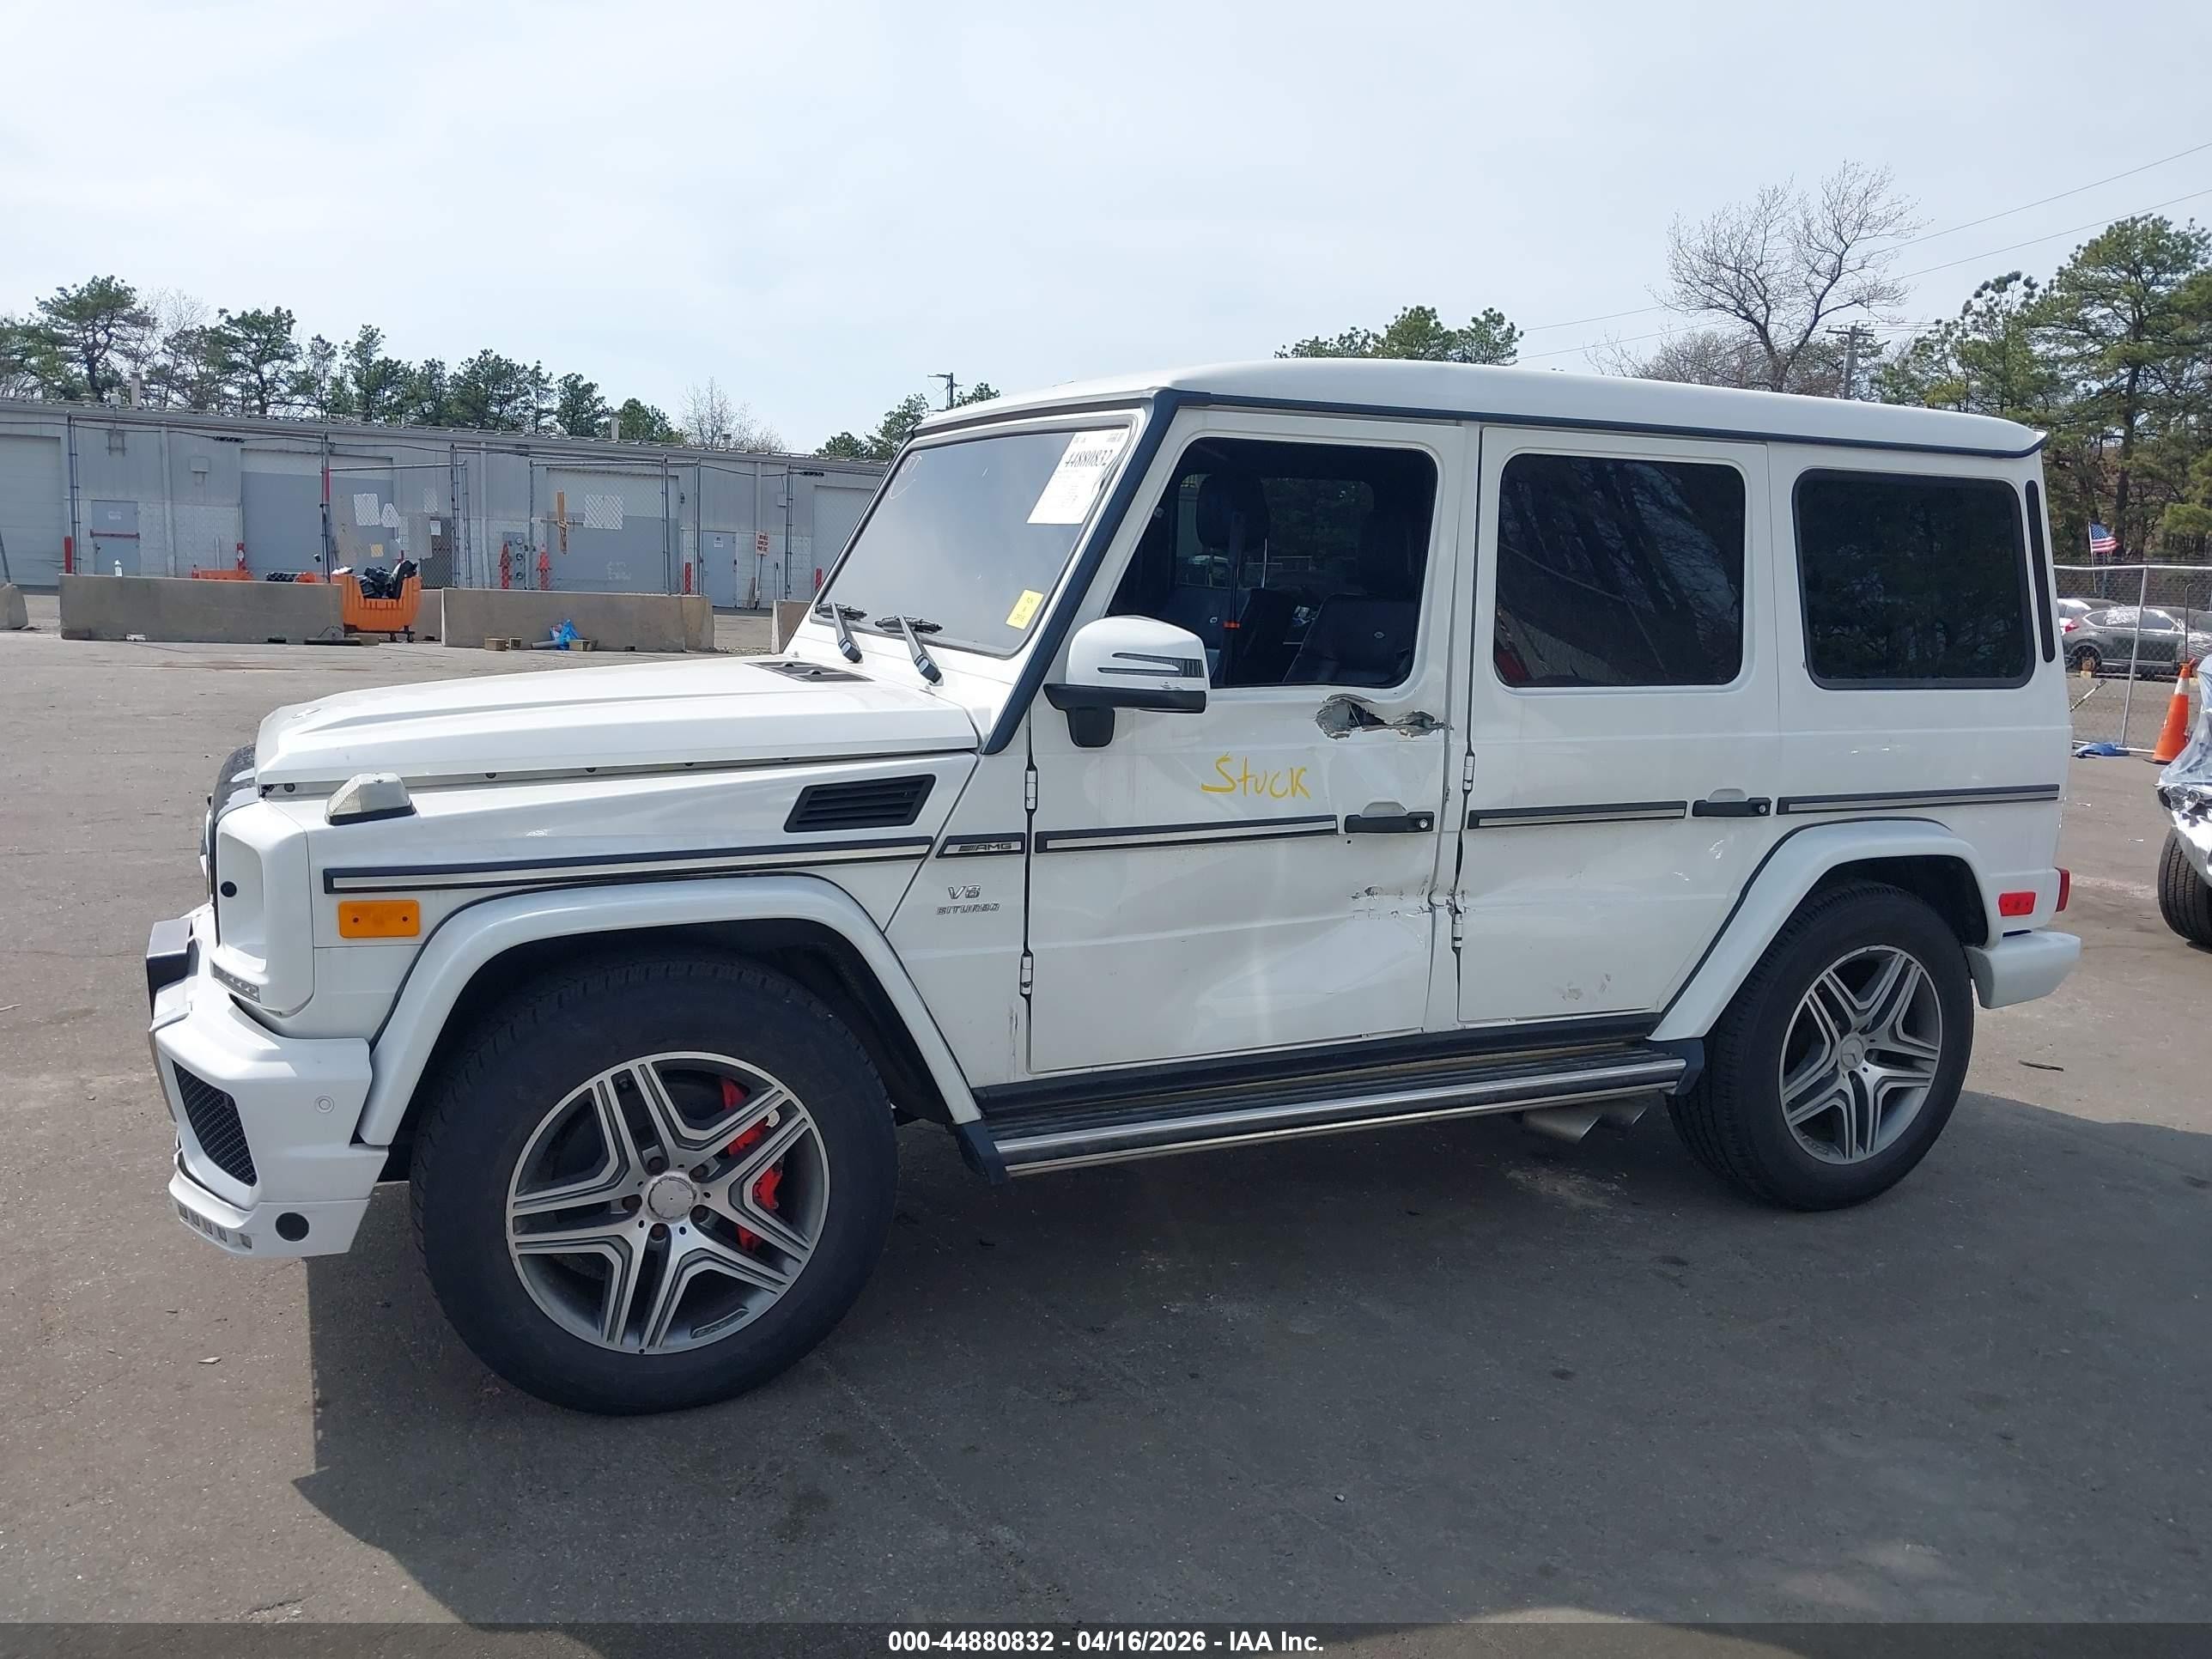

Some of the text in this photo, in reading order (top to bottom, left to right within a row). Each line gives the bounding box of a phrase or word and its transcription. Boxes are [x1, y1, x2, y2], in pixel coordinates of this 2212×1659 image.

[972, 842, 1012, 852] AMG
[948, 884, 981, 900] V8
[936, 902, 1000, 915] BITURBO
